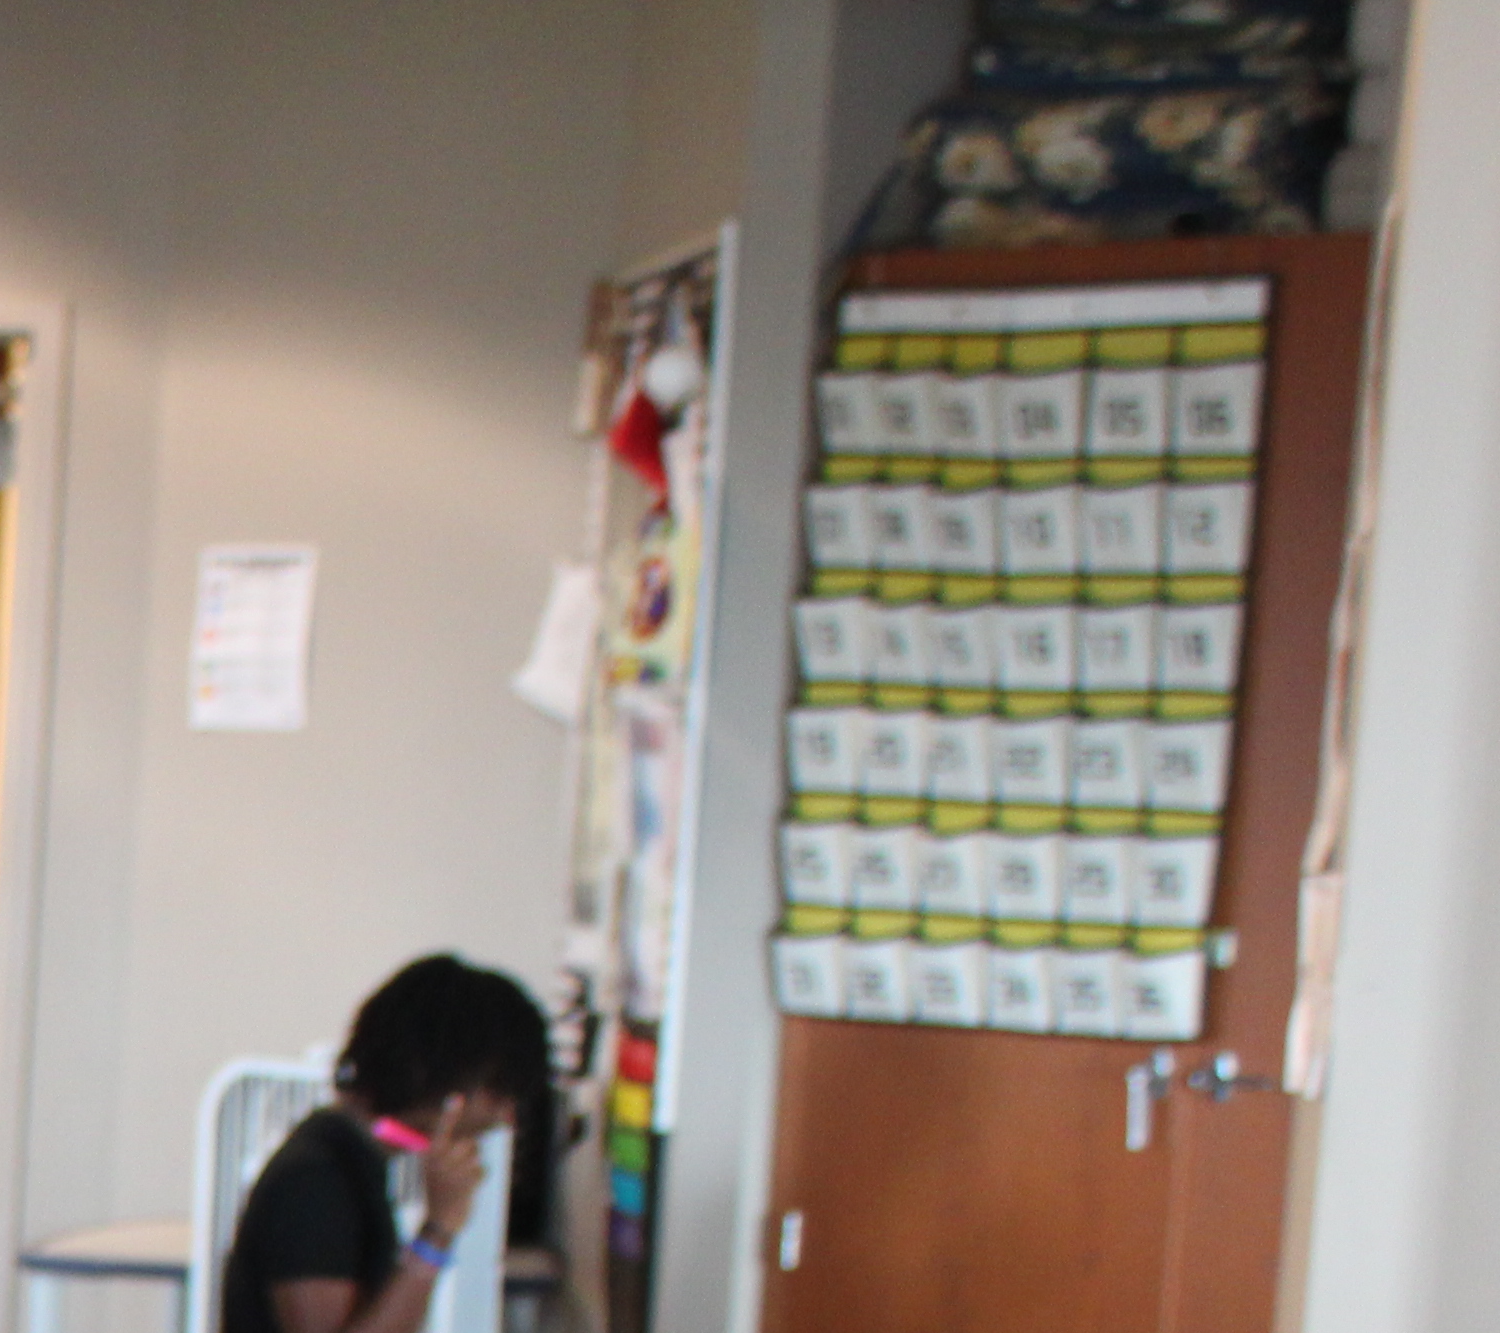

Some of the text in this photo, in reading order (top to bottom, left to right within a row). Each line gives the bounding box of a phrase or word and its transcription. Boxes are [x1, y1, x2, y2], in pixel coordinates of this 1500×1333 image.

[1102, 399, 1147, 436] 05
[1186, 399, 1234, 436] 06
[1009, 625, 1053, 664] 16
